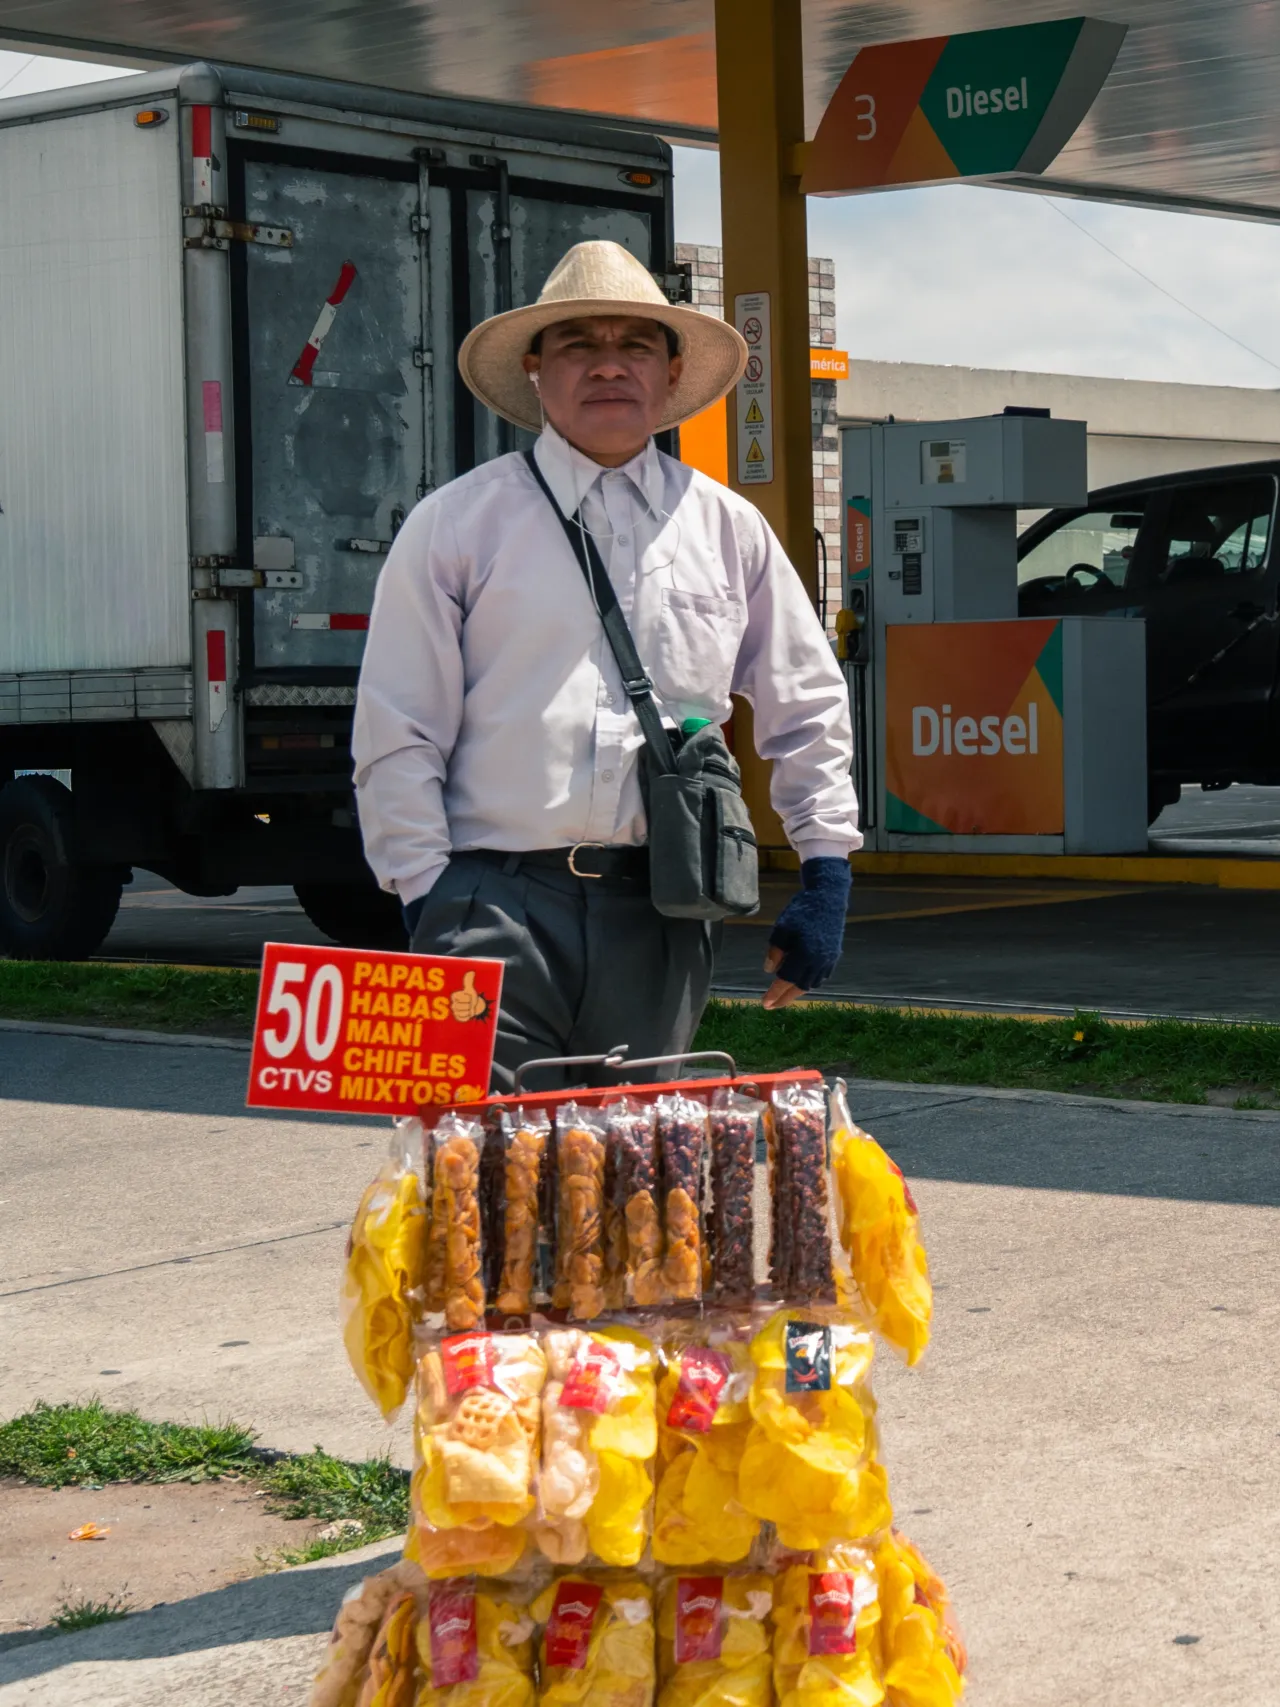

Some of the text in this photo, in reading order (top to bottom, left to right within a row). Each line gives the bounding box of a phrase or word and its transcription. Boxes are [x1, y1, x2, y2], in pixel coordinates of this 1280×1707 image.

[946, 77, 1029, 119] Diesel
[854, 94, 878, 141] 3
[855, 523, 864, 562] Diesel
[912, 702, 1038, 757] Diesel
[353, 961, 445, 992] PAPAS
[262, 962, 344, 1062] 50
[349, 990, 449, 1021] HABAS
[346, 1018, 424, 1047] MANÍ
[342, 1047, 467, 1079] CHIFLES
[258, 1066, 333, 1093] CTVS
[339, 1075, 452, 1105] MIXTOS
